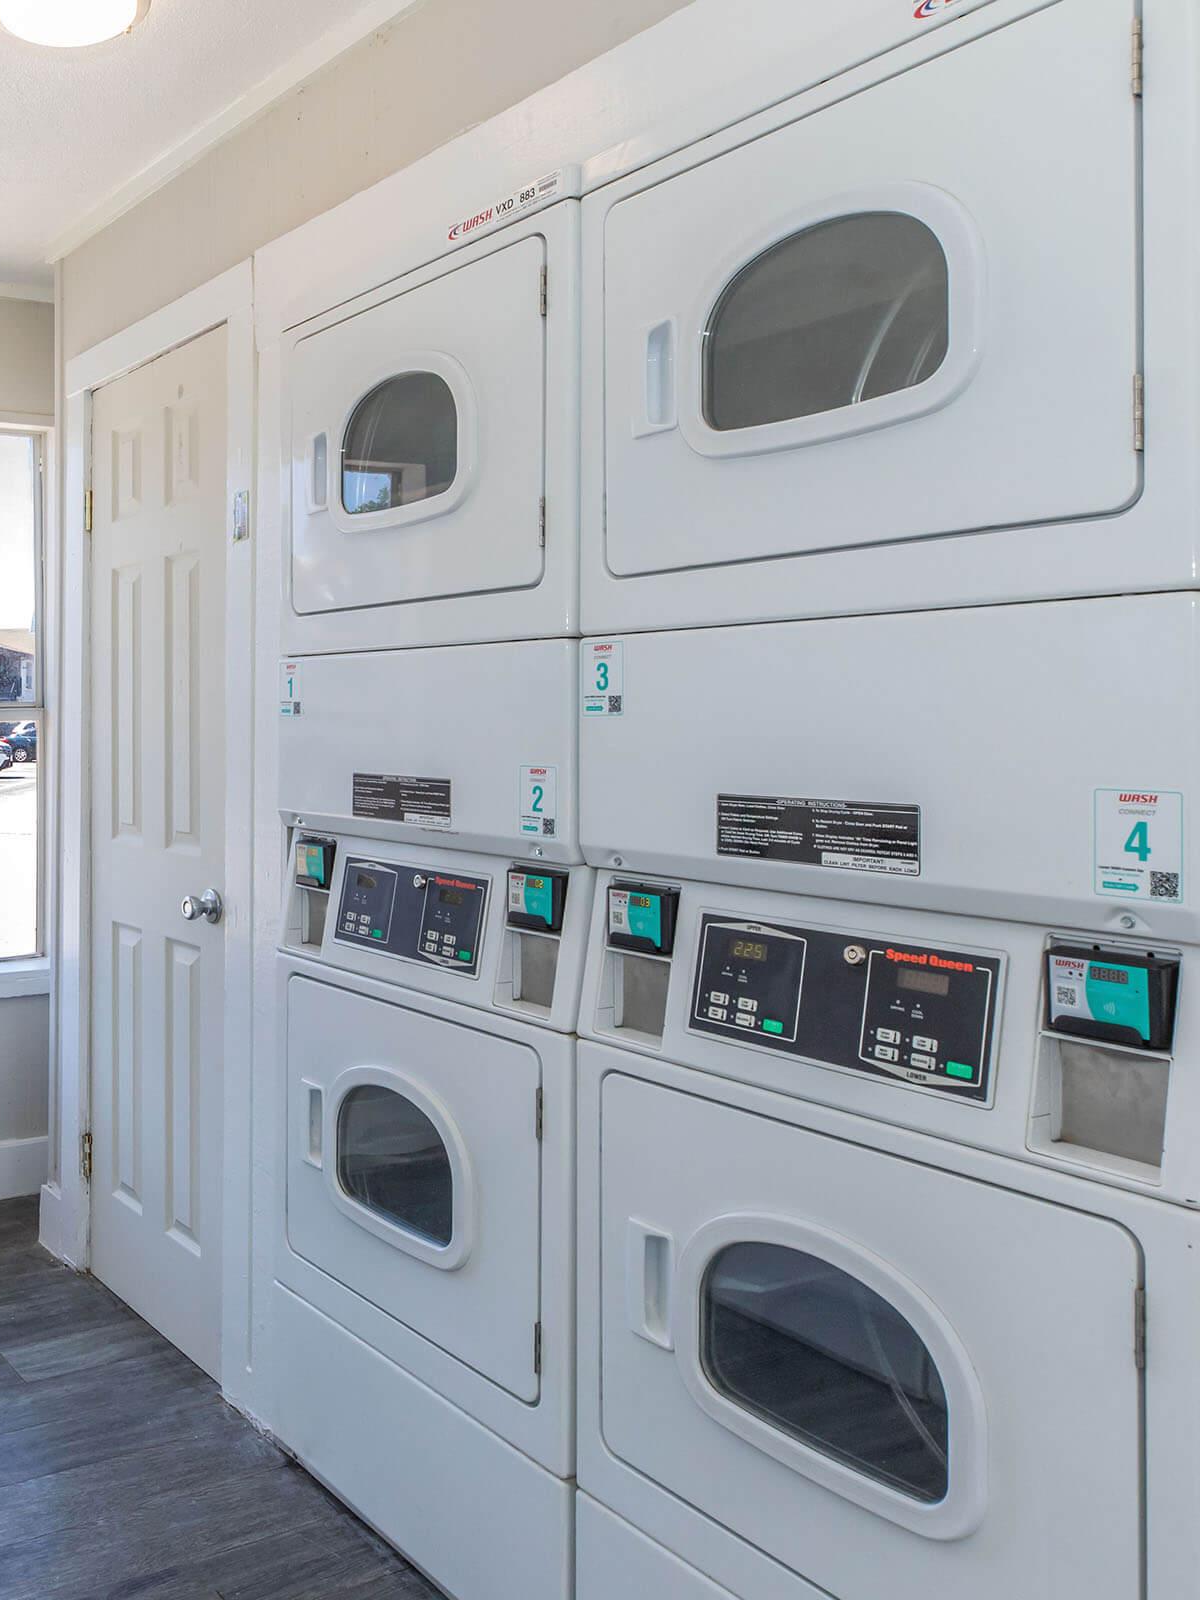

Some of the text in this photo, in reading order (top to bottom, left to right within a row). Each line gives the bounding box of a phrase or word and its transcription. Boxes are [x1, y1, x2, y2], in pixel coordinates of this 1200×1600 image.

[462, 208, 493, 233] WASH
[495, 198, 514, 215] VXD
[519, 187, 536, 203] 883
[596, 662, 609, 691] 3
[287, 677, 293, 698] 1
[532, 785, 544, 813] 2
[1119, 793, 1159, 804] WASH
[1118, 808, 1157, 817] CONNECT
[1124, 821, 1151, 862] 4
[734, 941, 762, 959] 225
[885, 948, 974, 973] Speed Queen
[1055, 959, 1085, 969] WASH
[906, 1071, 927, 1081] LOWER
